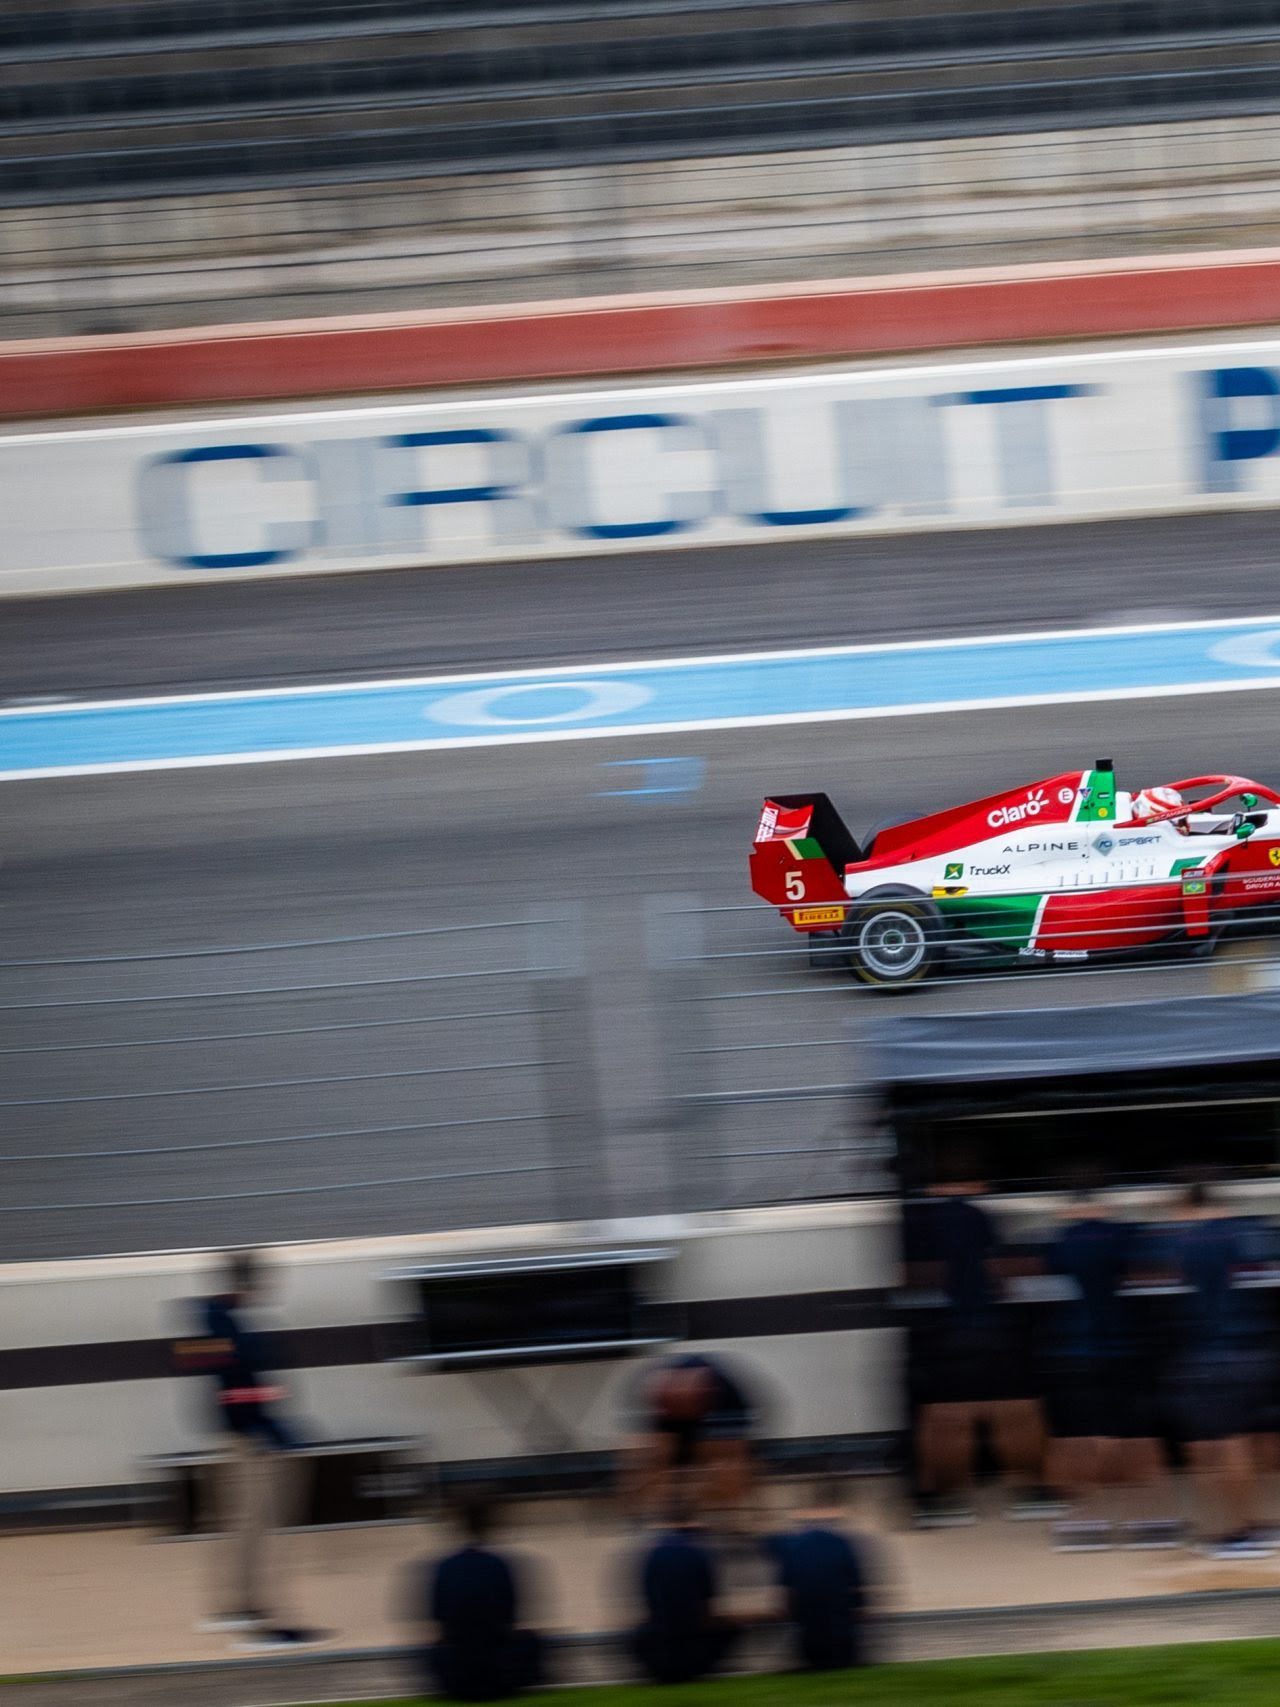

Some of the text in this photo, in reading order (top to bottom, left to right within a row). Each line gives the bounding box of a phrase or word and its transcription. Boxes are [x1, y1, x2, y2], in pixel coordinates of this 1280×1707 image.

[137, 382, 1103, 569] CIRCUIT
[987, 790, 1049, 827] Claro
[1002, 842, 1079, 853] ALPINE
[1118, 835, 1162, 847] SPORT
[969, 864, 1011, 876] TruckX
[785, 871, 806, 901] 5
